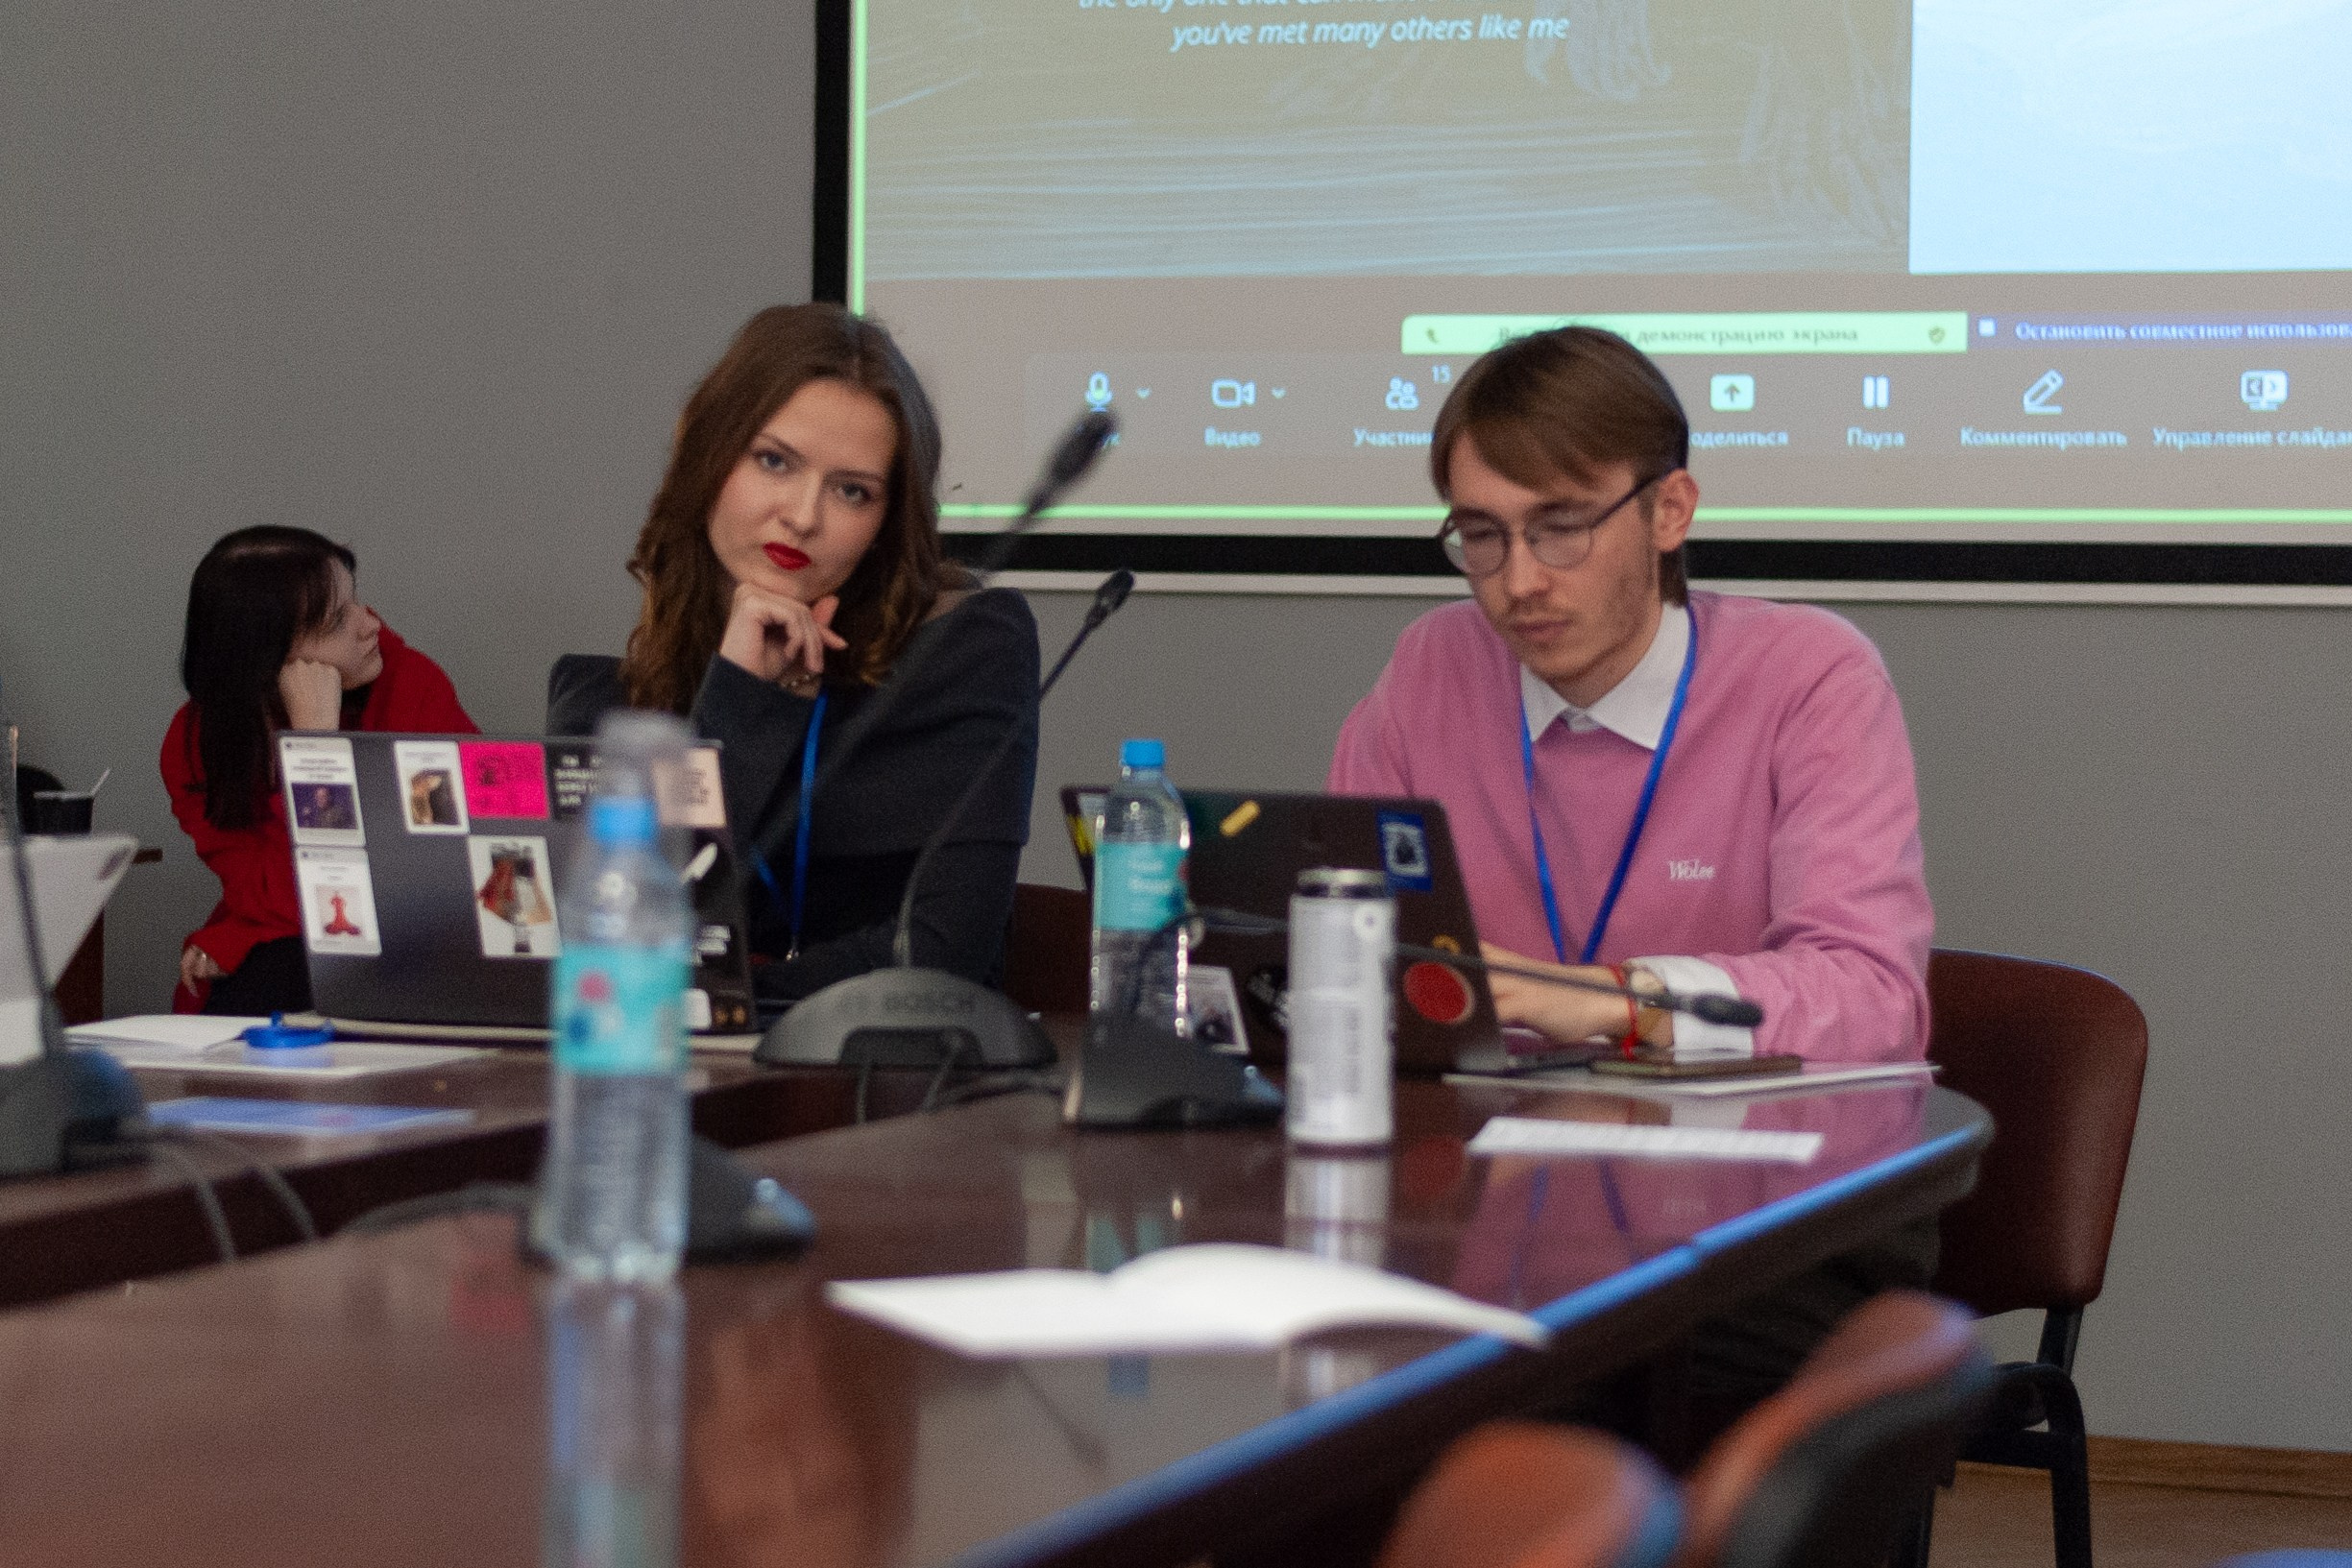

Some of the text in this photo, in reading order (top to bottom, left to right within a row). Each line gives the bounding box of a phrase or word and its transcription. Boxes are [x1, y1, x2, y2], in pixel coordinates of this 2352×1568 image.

[1169, 13, 1570, 53] you've met many others like me
[1637, 330, 1784, 348] демонстрацию
[1792, 329, 1857, 347] экрана
[2015, 321, 2125, 340] Остановить
[2129, 323, 2243, 339] совместное
[1204, 427, 1261, 448] Видео
[1352, 426, 1433, 447] Участни
[1690, 431, 1788, 449] оделиться
[1846, 426, 1905, 451] Пауза
[1960, 425, 2127, 451] Комментировать
[2152, 426, 2272, 452] Управление
